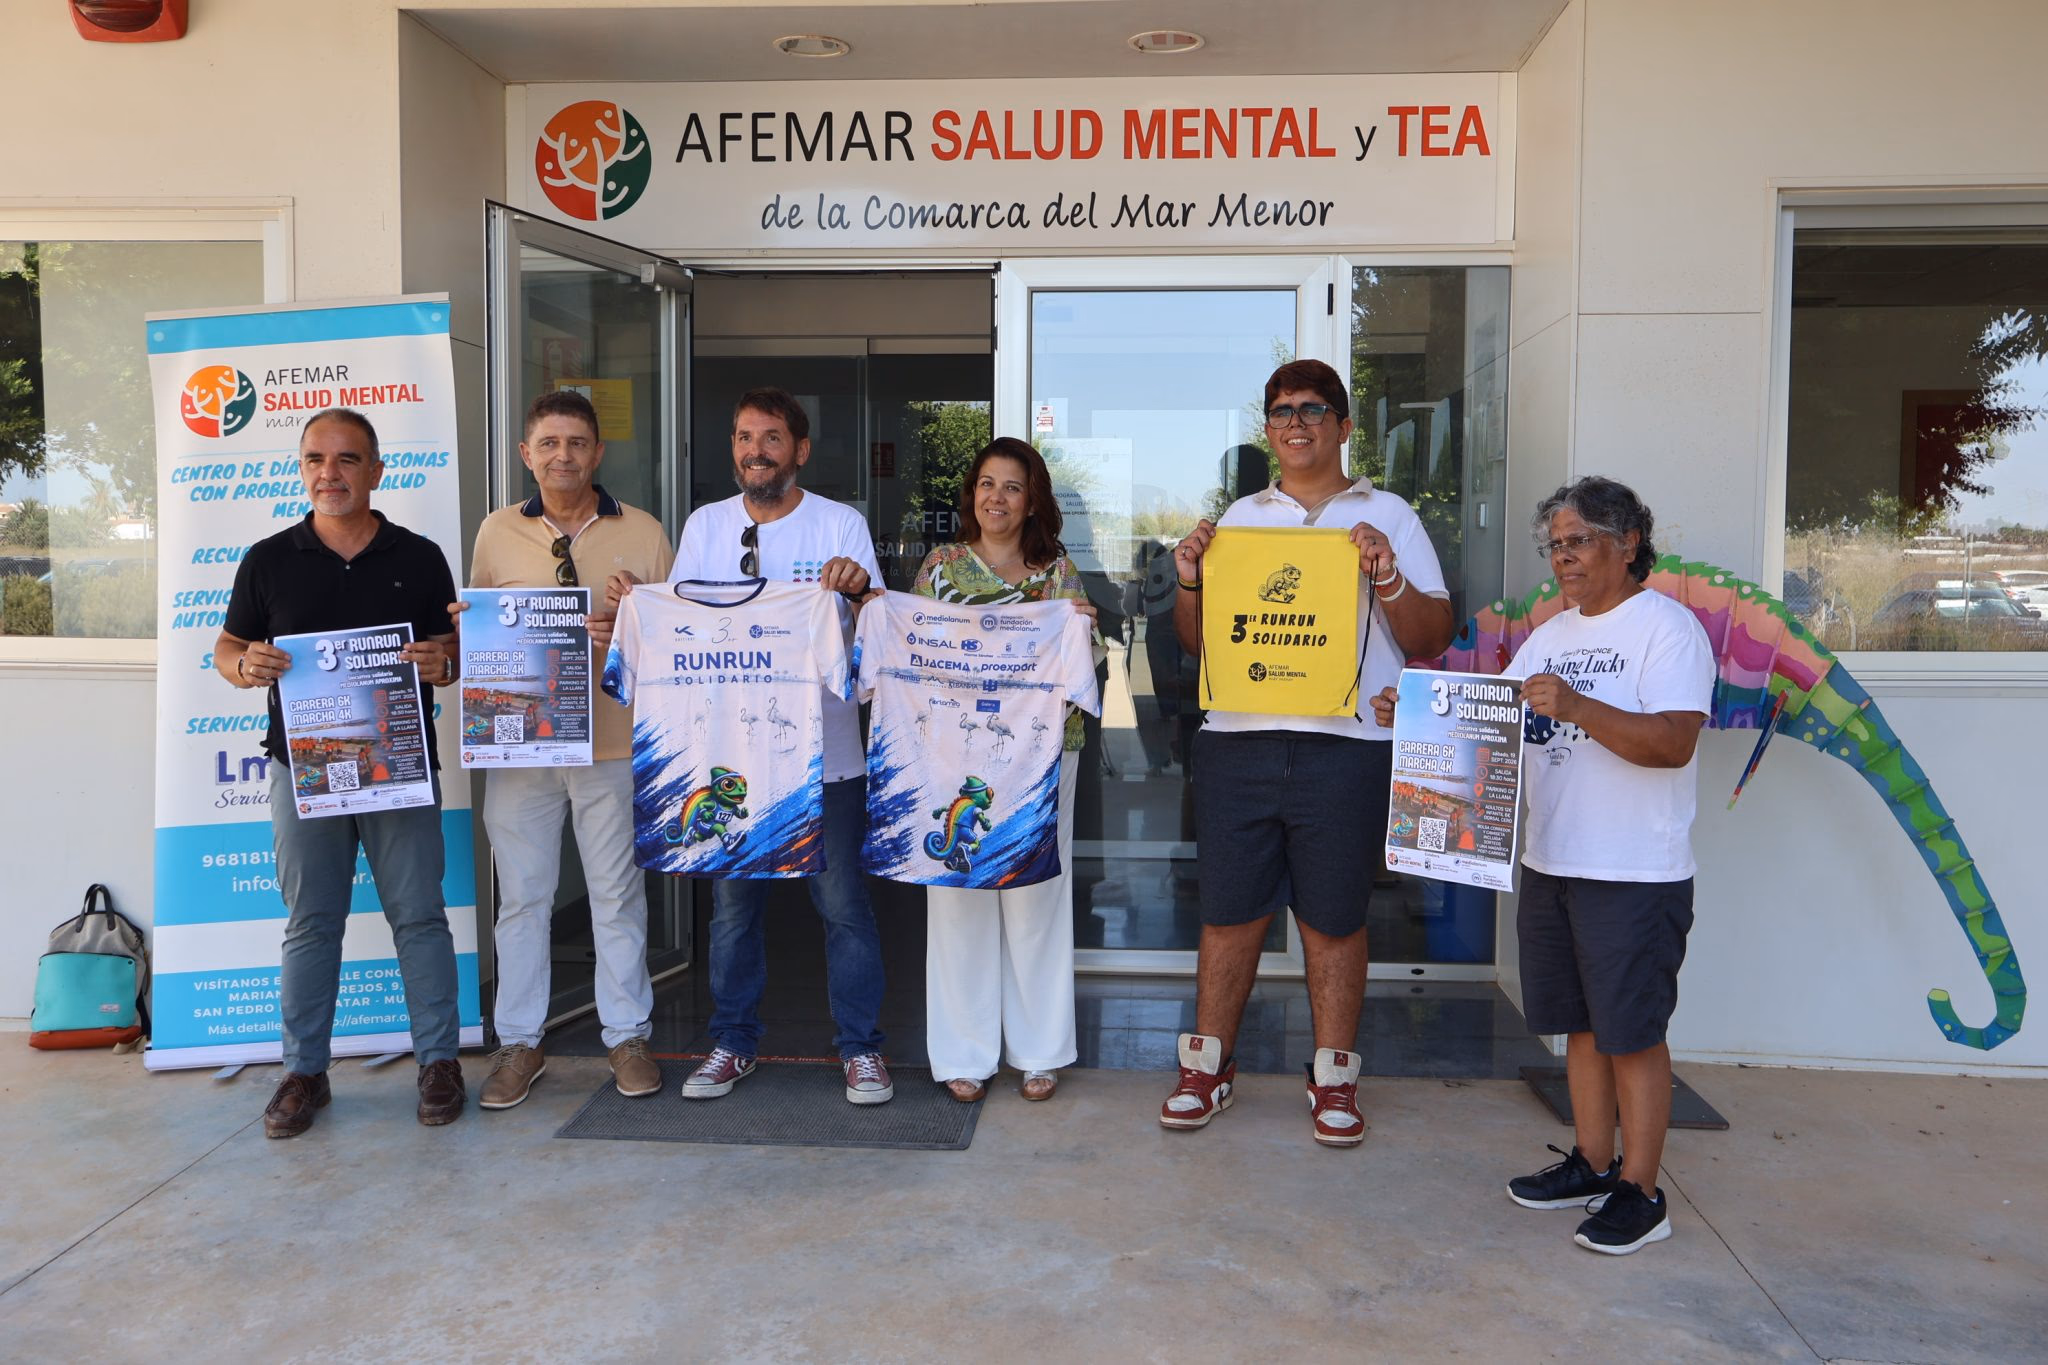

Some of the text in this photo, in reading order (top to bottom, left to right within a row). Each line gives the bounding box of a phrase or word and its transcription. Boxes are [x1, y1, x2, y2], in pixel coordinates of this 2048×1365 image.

[675, 105, 1491, 163] AFEMAR SALUD MENTAL y TEA
[761, 191, 1334, 230] de la Comarca del Mar Menor
[264, 365, 349, 386] AFEMAR
[264, 383, 424, 412] SALUD MENTAL
[266, 415, 304, 428] mar
[171, 452, 450, 484] CENTRO DE DÍA RSONAS
[190, 472, 426, 502] CON PROBLE ALUD
[875, 542, 926, 557] SALUD
[172, 589, 234, 608] SERVIC
[530, 596, 578, 610] RUNRUN
[524, 613, 585, 627] SOLIDARIO
[927, 615, 971, 624] mediolanum
[1260, 613, 1316, 627] RUNRUN
[350, 633, 401, 652] RUNRUN
[918, 637, 957, 649] INSAL
[1252, 632, 1328, 647] SOLIDARIO
[467, 651, 526, 662] CARRERA 6K
[674, 651, 772, 671] RUNRUN
[468, 664, 525, 675] MARCHA 4K
[923, 659, 971, 672] JACEMA
[980, 663, 1037, 673] proexport
[1583, 653, 1629, 679] Lucky
[375, 677, 402, 685] APROXIMA
[674, 674, 772, 686] SOLIDARIO
[1464, 683, 1512, 703] RUNRUN
[289, 695, 351, 712] CARRERA 6K
[292, 708, 352, 726] MARCHA 4K
[1456, 703, 1518, 724] SOLIDARIO
[1448, 732, 1507, 744] MEDIOLANUM APROXIMA
[1479, 726, 1500, 735] solidaria
[1399, 740, 1455, 759] CARRERA 6K
[1399, 755, 1453, 773] MARCHA 4K
[719, 812, 730, 821] 127
[194, 977, 270, 991] VISÍTANOS
[340, 983, 387, 994] REJOS,
[194, 1007, 222, 1018] SAN
[226, 1003, 274, 1016] PEDRO
[336, 997, 370, 1008] ATAR
[208, 1024, 234, 1036] Más
[236, 1020, 282, 1034] detalle
